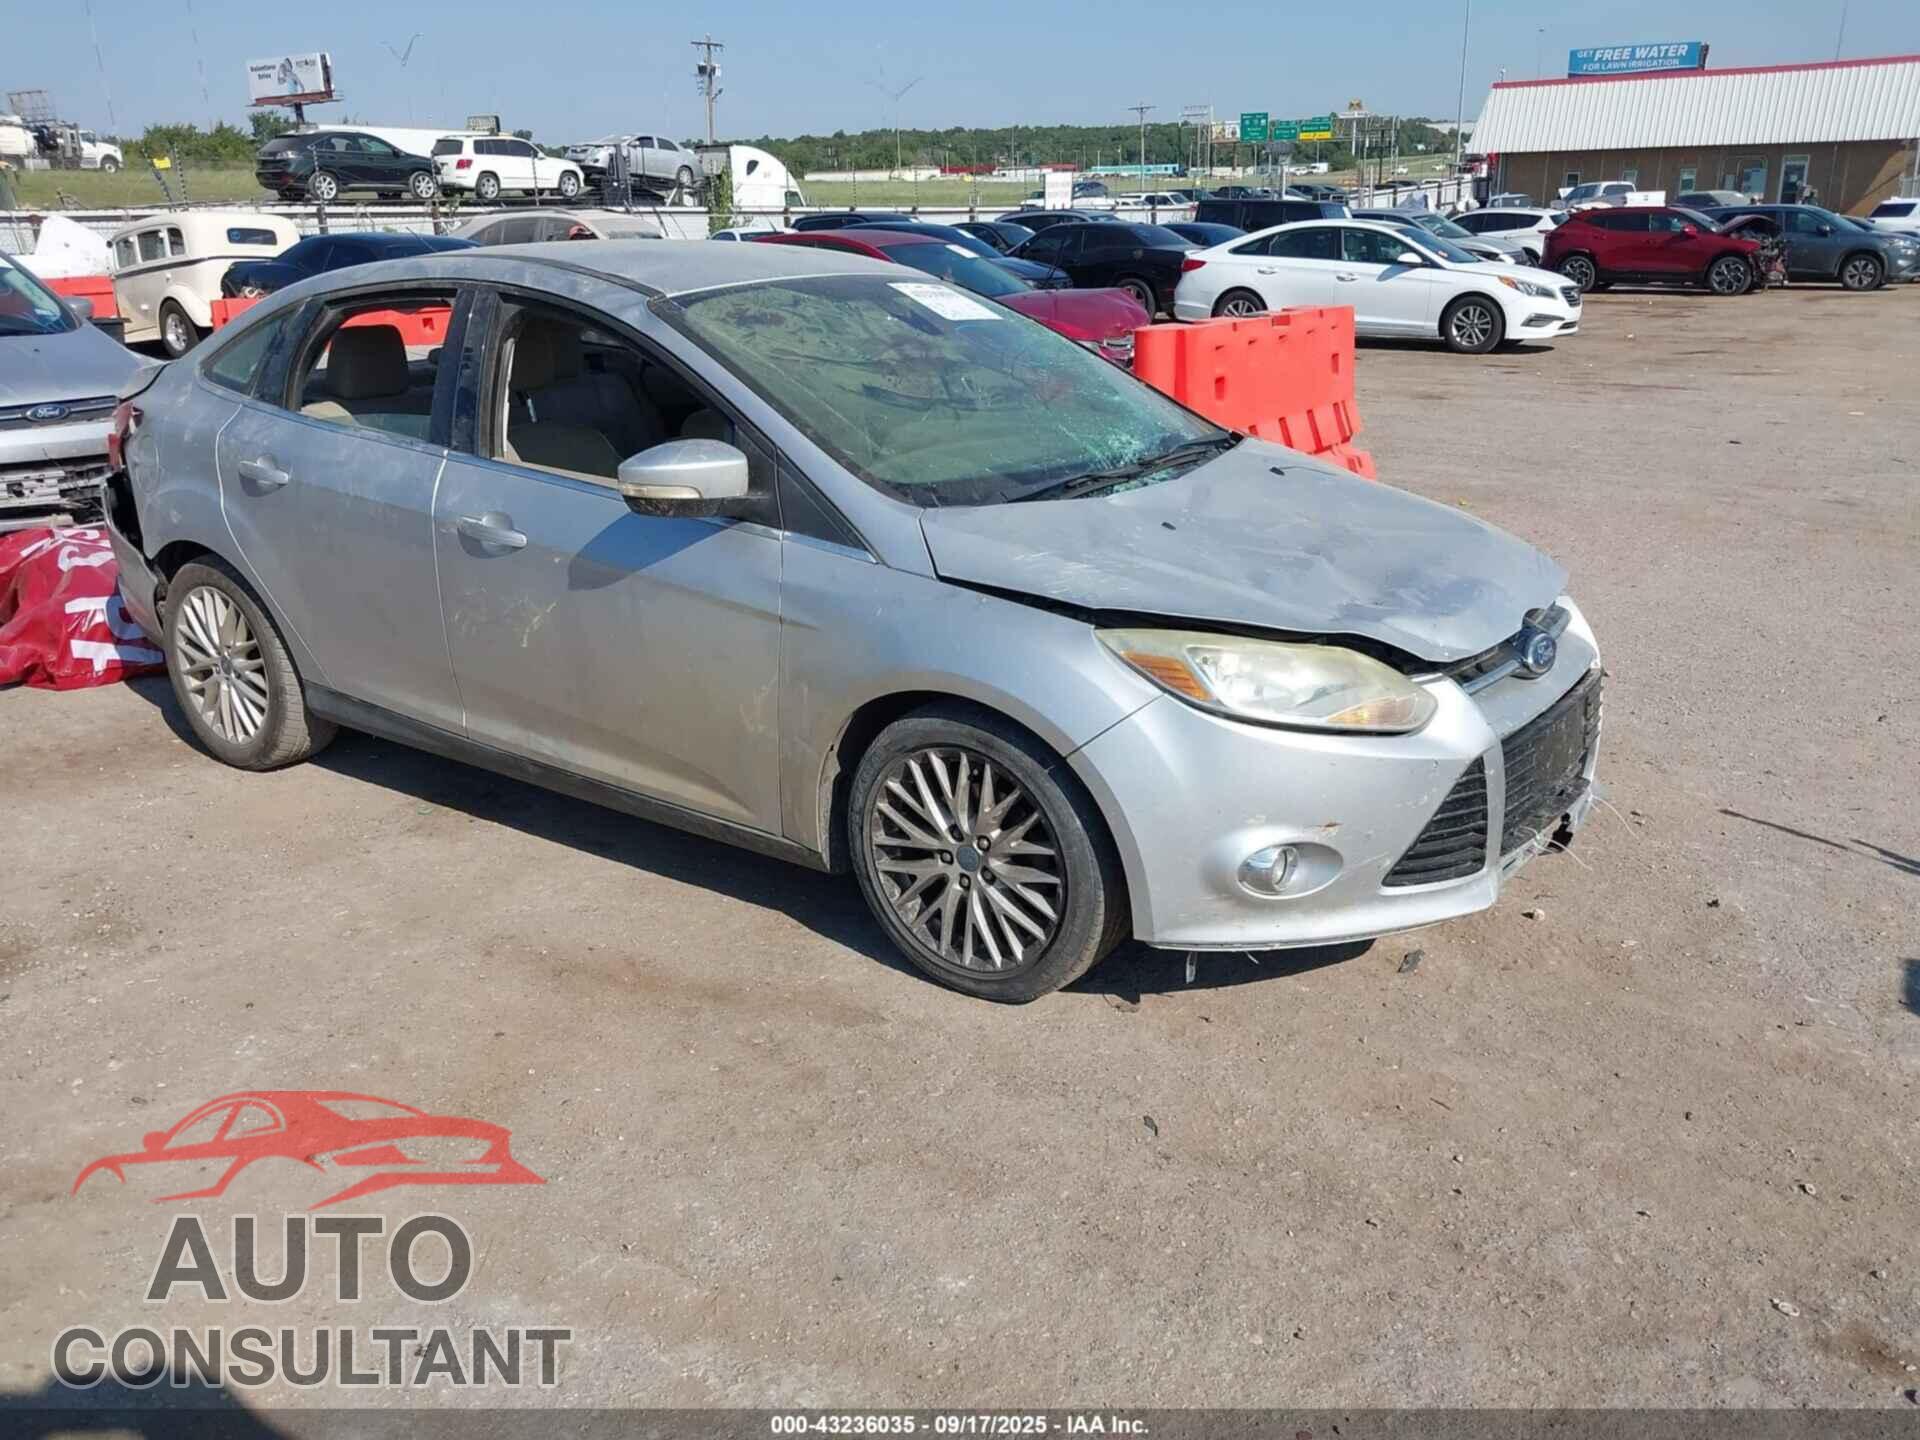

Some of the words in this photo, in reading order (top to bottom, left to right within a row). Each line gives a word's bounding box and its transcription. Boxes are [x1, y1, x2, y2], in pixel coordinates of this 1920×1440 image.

[1577, 49, 1593, 58] GET
[1593, 47, 1633, 61] FREE
[1635, 44, 1689, 60] WATER
[1583, 63, 1600, 71] FOR
[1601, 61, 1627, 71] LAWN
[1628, 58, 1680, 69] IRRIGATION
